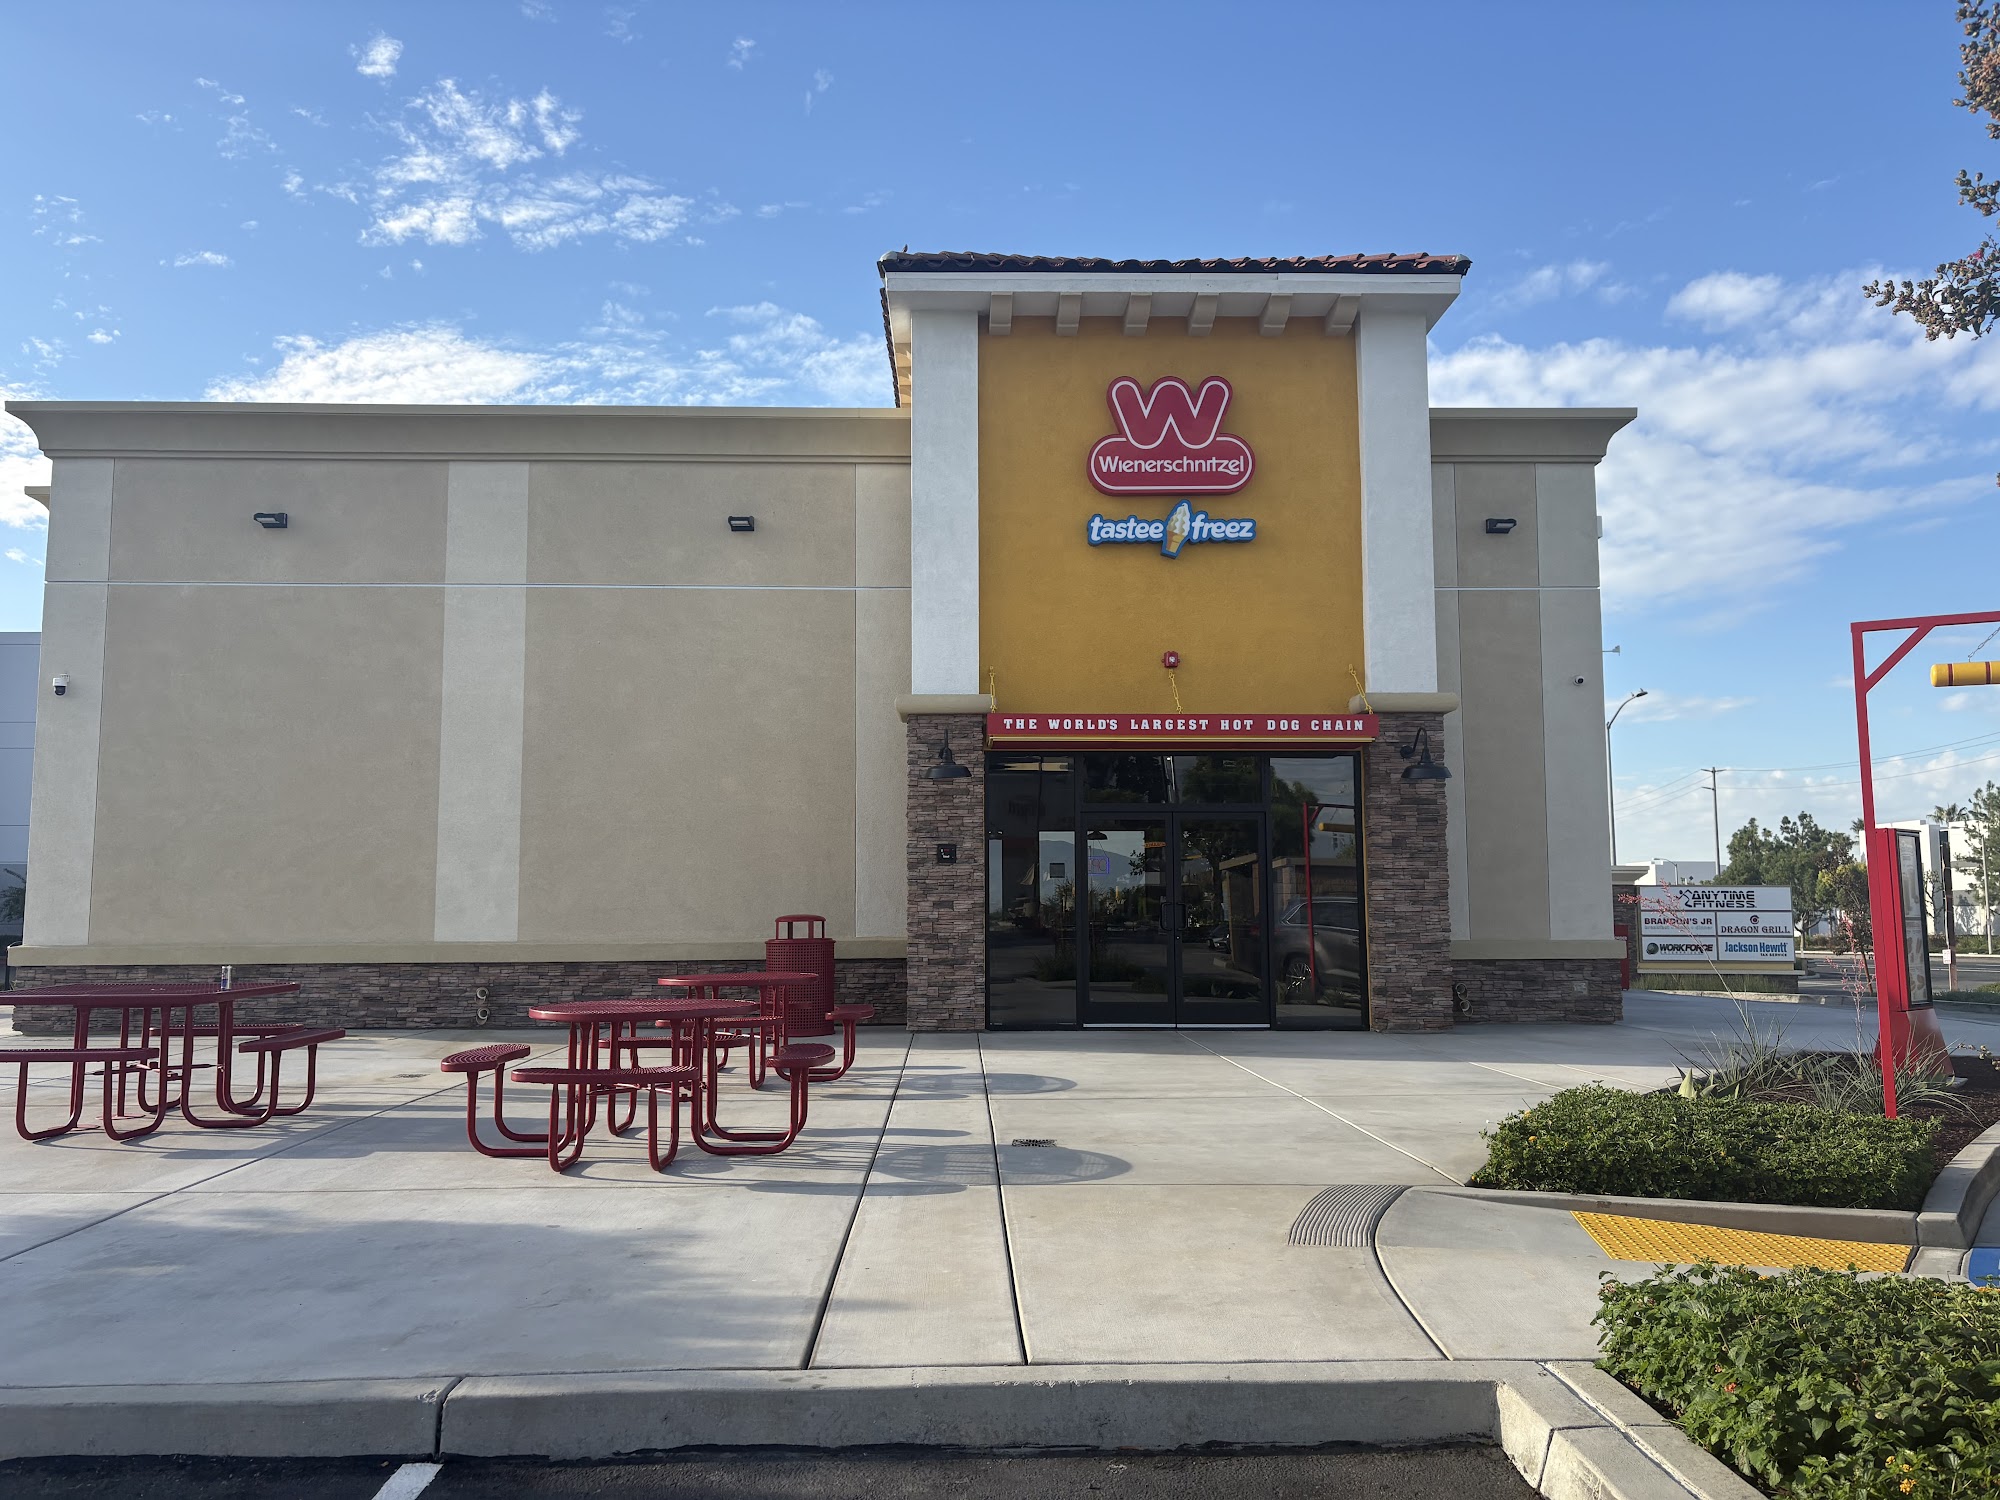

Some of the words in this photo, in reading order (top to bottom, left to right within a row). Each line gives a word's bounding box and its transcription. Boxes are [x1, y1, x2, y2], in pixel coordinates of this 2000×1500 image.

[1112, 380, 1229, 450] W
[1098, 455, 1245, 476] Wienerschnitzel
[1090, 516, 1164, 542] tastee
[1191, 513, 1254, 540] freez
[1003, 718, 1038, 730] THE
[1048, 718, 1118, 730] WORLD'S
[1130, 719, 1209, 730] LARGEST
[1220, 719, 1254, 731] HOT
[1267, 719, 1300, 731] DOG
[1310, 719, 1364, 731] CHAIN
[1691, 890, 1755, 900] ANYTIME
[1693, 900, 1756, 908] FITNESS
[1700, 917, 1713, 925] JR
[1721, 925, 1759, 934] DRAGON
[1761, 925, 1791, 934] GRILL
[1660, 943, 1713, 953] WORKFORCE
[1724, 941, 1758, 953] Jackson
[1759, 942, 1787, 953] Hewitt
